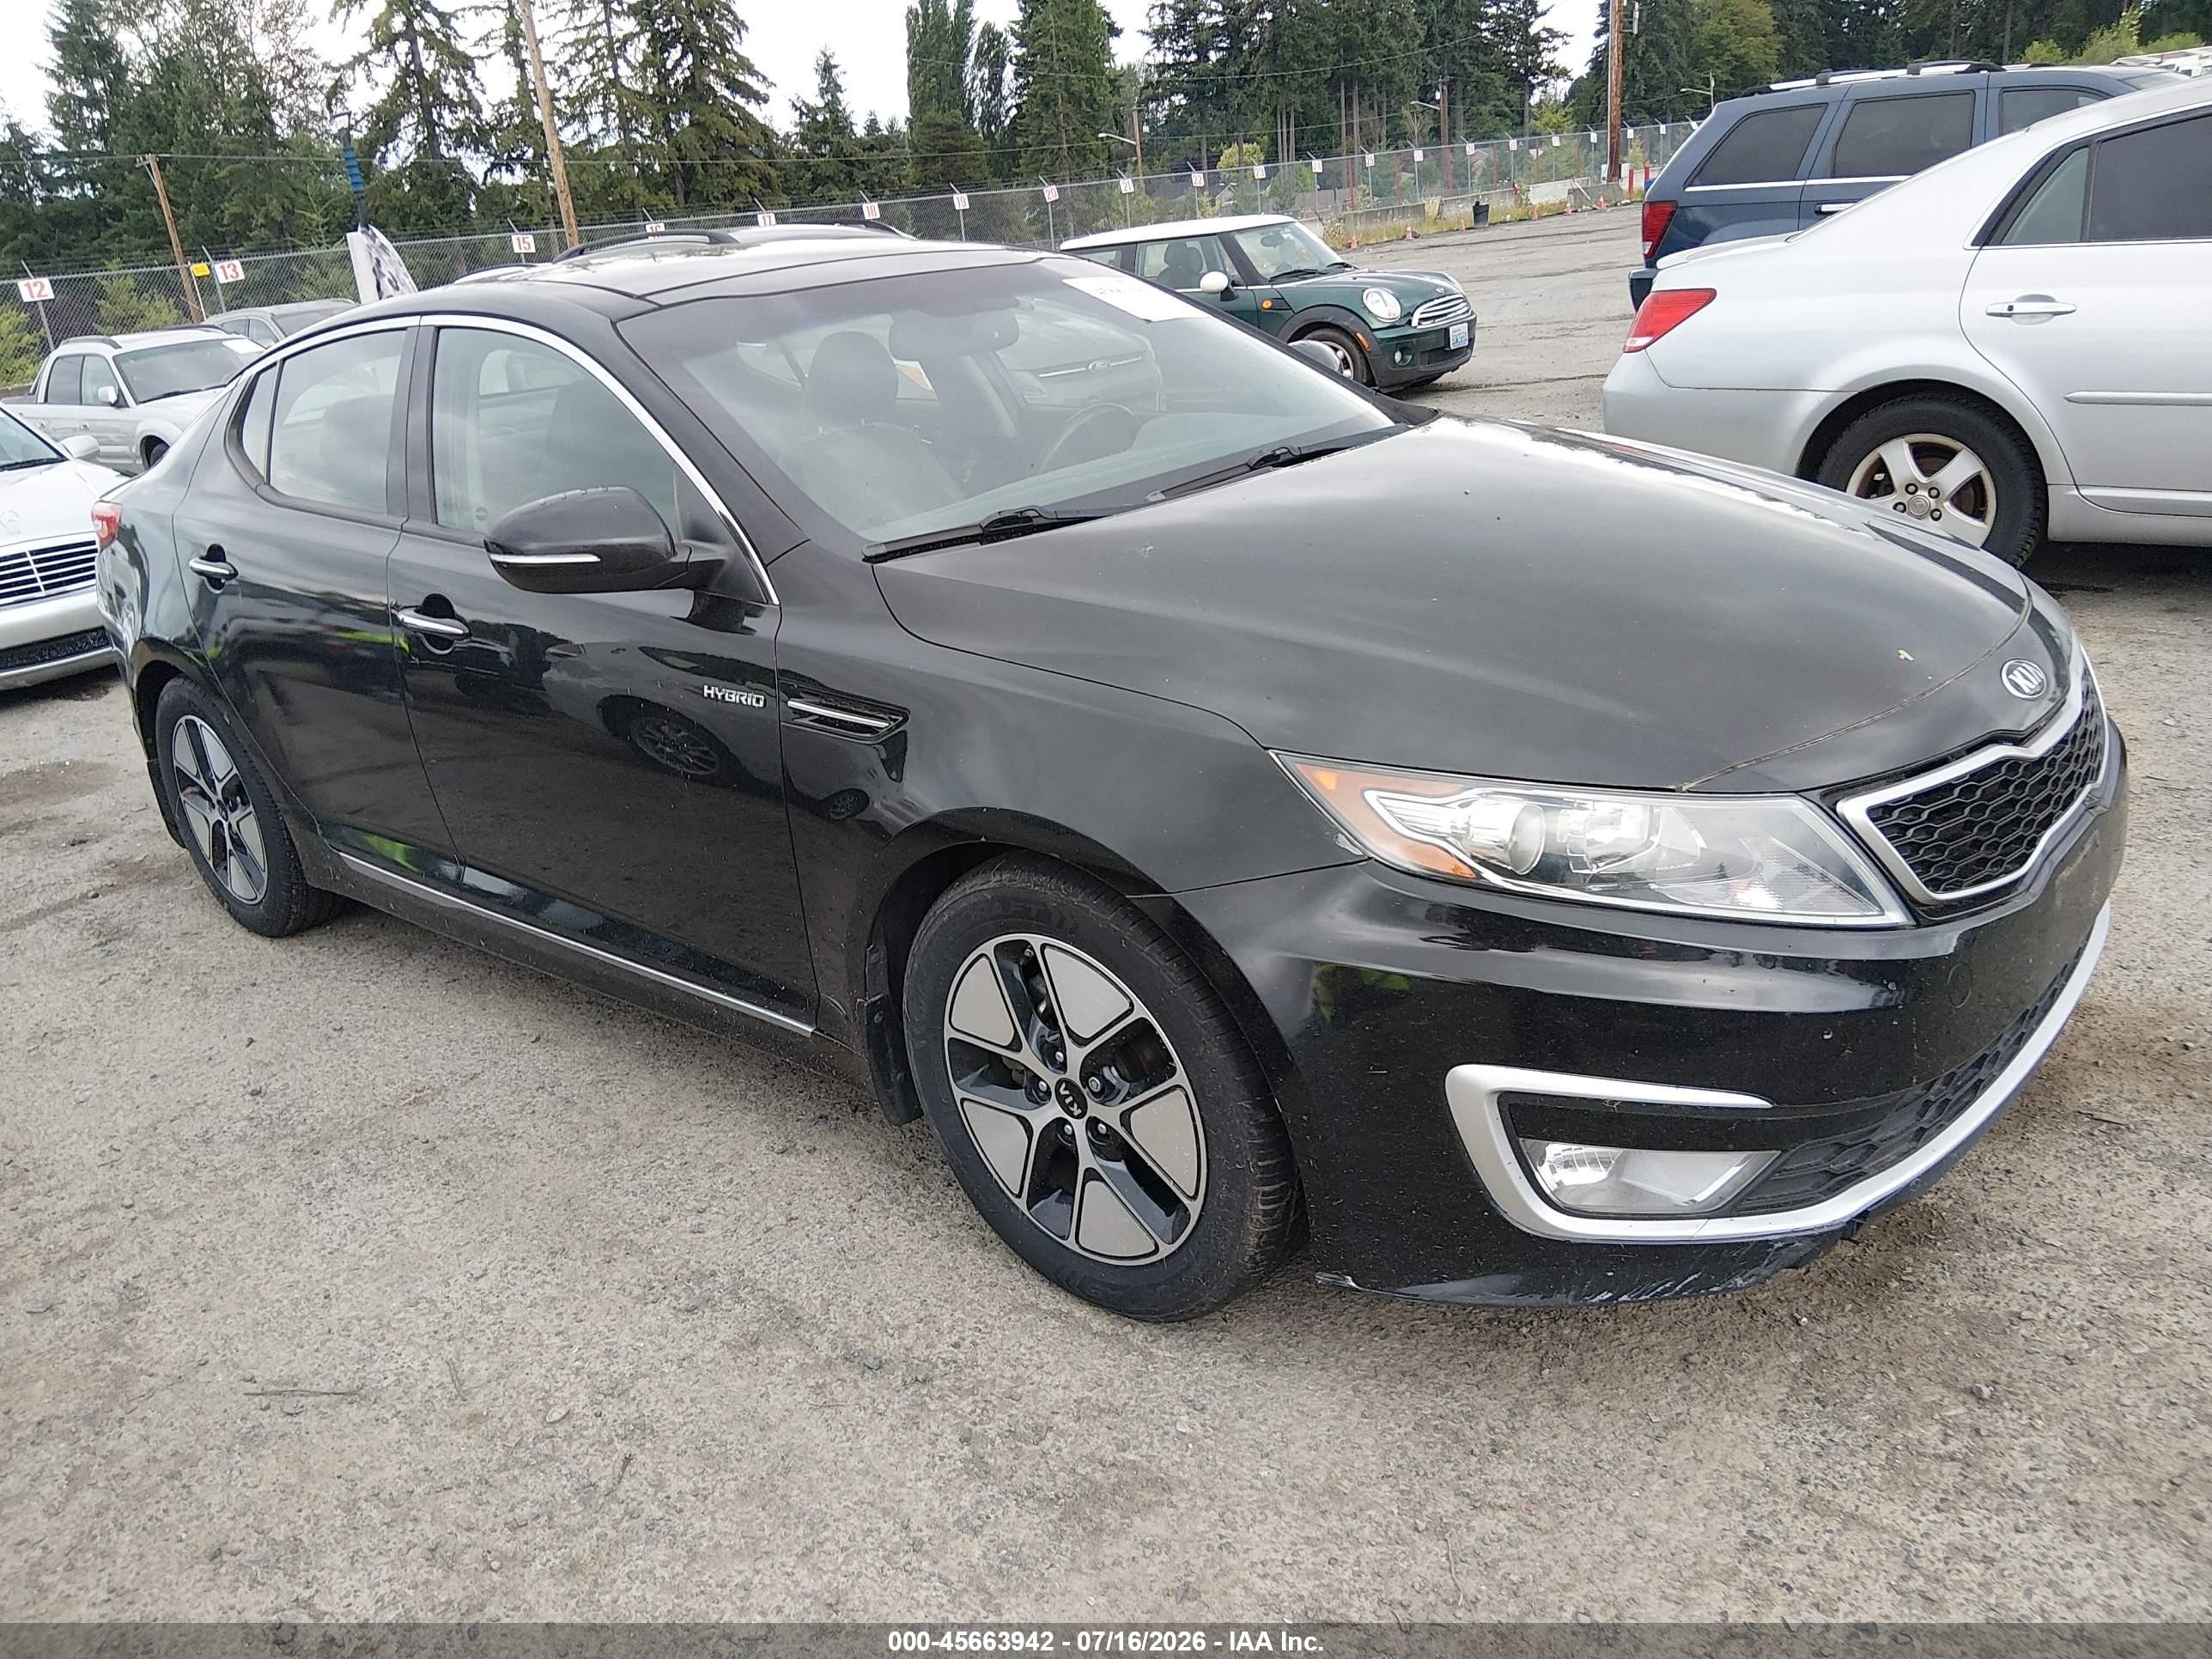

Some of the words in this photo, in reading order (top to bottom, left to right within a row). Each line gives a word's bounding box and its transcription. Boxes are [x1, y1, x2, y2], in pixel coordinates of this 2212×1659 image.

[957, 195, 967, 206] 19
[1045, 186, 1056, 200] 20
[865, 205, 876, 216] 18
[760, 215, 772, 226] 17
[516, 236, 531, 251] 15
[220, 262, 240, 282] 13
[24, 281, 48, 299] 12
[703, 684, 764, 708] HYBRID
[1059, 1082, 1082, 1116] KIA
